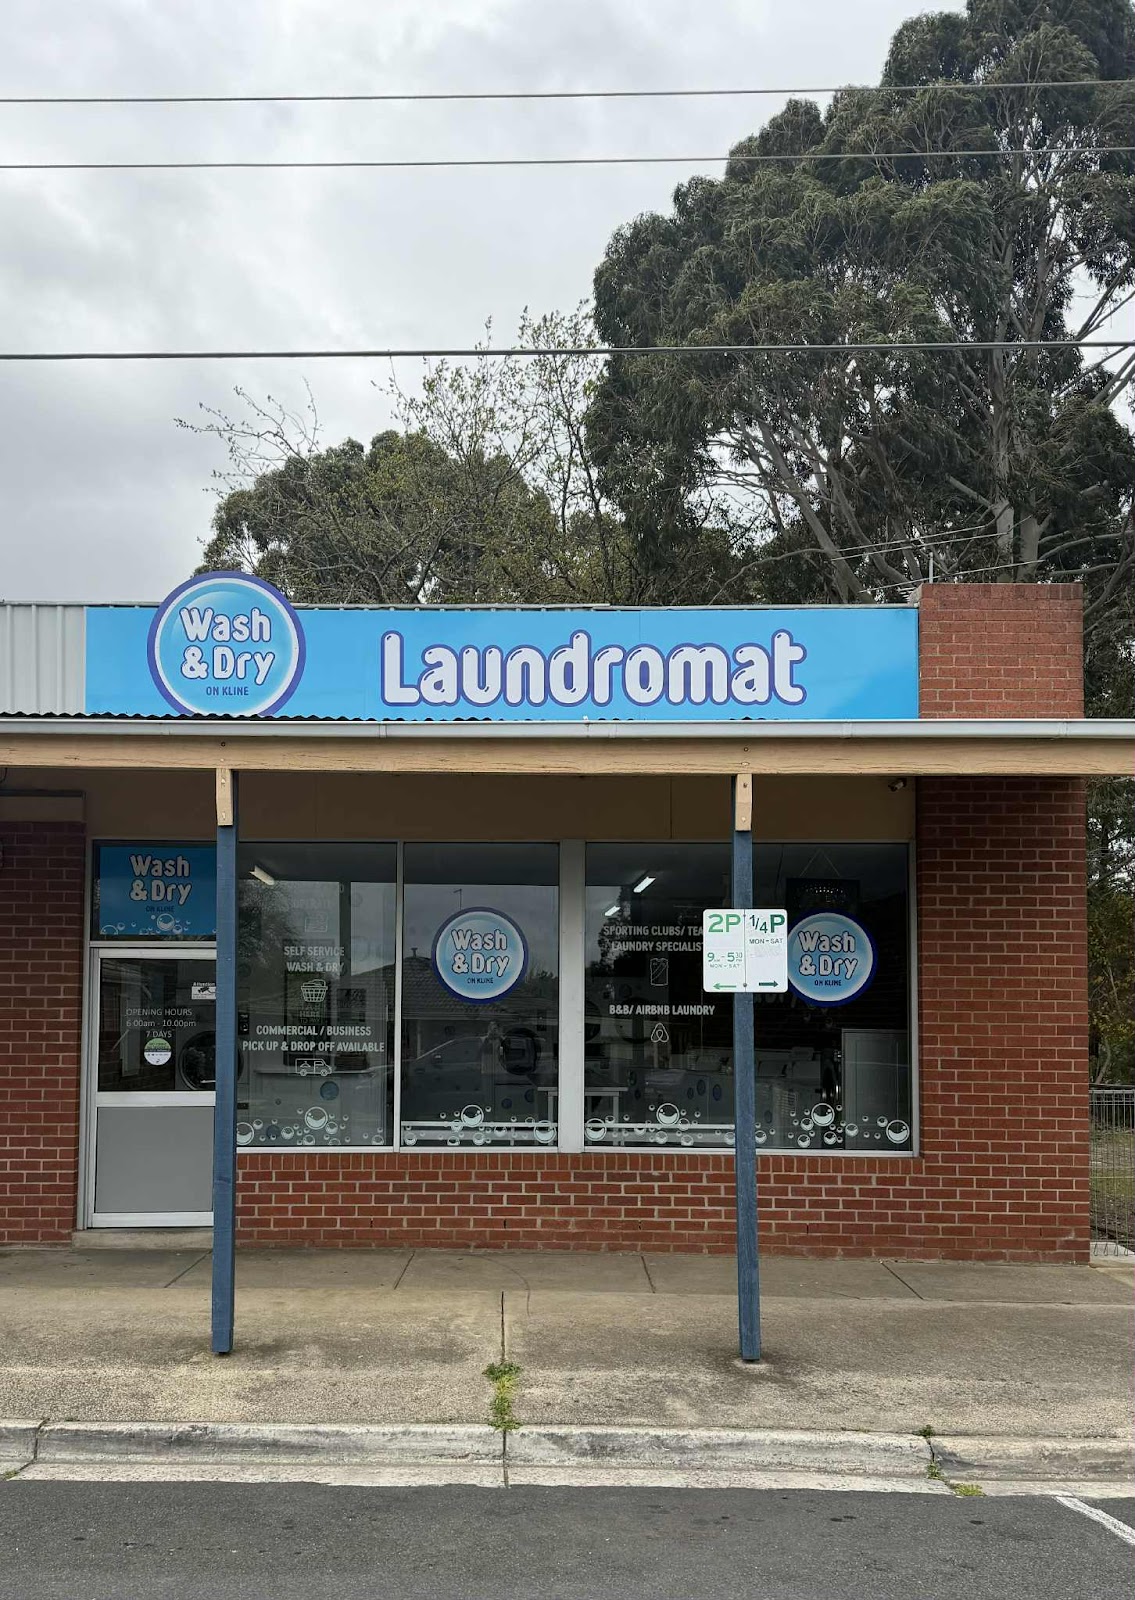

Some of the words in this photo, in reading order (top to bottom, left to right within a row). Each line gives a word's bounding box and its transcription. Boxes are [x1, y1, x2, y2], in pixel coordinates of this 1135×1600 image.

[179, 607, 272, 642] Wash
[181, 645, 209, 680] &
[213, 645, 275, 685] Dry
[381, 629, 807, 707] Laundromat
[206, 686, 219, 696] ON
[222, 686, 249, 696] KLINE
[128, 854, 190, 877] Wash
[129, 879, 148, 901] &
[151, 879, 192, 905] Dry
[603, 926, 649, 936] SPORTING
[651, 926, 685, 936] CLUBS/
[708, 914, 741, 932] 2P
[451, 929, 507, 951] Wash
[611, 941, 654, 951] LAUNDRY
[656, 941, 704, 951] SPECIALIS
[798, 931, 855, 953] Wash
[284, 946, 305, 956] SELF
[307, 946, 344, 956] SERVICE
[286, 962, 314, 972] WASH
[316, 962, 324, 972] &
[325, 962, 344, 972] DRY
[452, 952, 469, 974] &
[471, 952, 509, 977] Dry
[799, 954, 817, 976] &
[819, 954, 858, 980] Dry
[609, 1005, 634, 1015] B&B/
[635, 1005, 670, 1015] AIRBNB
[672, 1005, 715, 1016] LAUNDRY
[256, 1025, 318, 1036] COMMERCIAL
[327, 1025, 371, 1036] BUSINESS
[242, 1041, 265, 1051] PICK
[267, 1041, 279, 1051] UP
[281, 1041, 288, 1051] &
[290, 1041, 316, 1051] DROP
[318, 1041, 335, 1051] OFF
[336, 1041, 385, 1052] AVAILABLE
